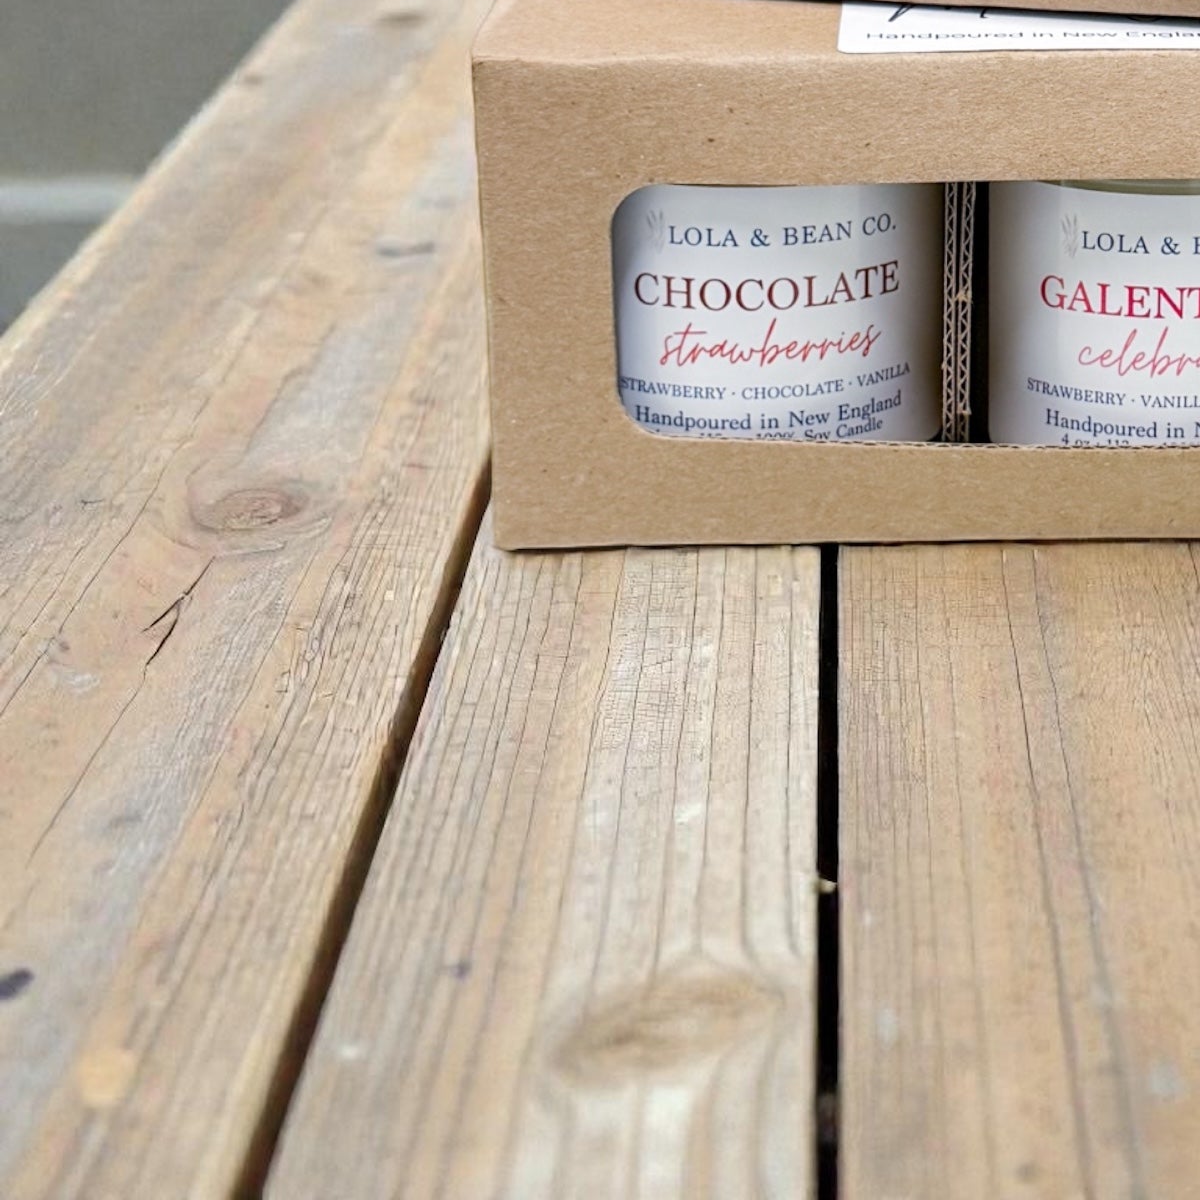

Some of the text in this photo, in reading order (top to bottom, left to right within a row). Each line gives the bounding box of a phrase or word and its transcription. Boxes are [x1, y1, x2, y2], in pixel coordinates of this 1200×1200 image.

[867, 32, 1023, 40] Handpoured
[1063, 31, 1118, 39] New
[668, 213, 897, 247] LOLA & BEAN CO.
[1082, 230, 1151, 254] LOLA
[1160, 236, 1181, 255] &
[633, 259, 900, 312] CHOCOLATE
[659, 318, 882, 368] strawberries
[741, 379, 844, 400] CHOCOLATE
[857, 362, 911, 387] VANILLA
[1027, 377, 1126, 406] STRAWBERRY
[635, 389, 902, 432] Handpoured in New England
[1046, 408, 1157, 438] Handpoured
[1167, 422, 1185, 439] in
[836, 416, 884, 439] Candle
